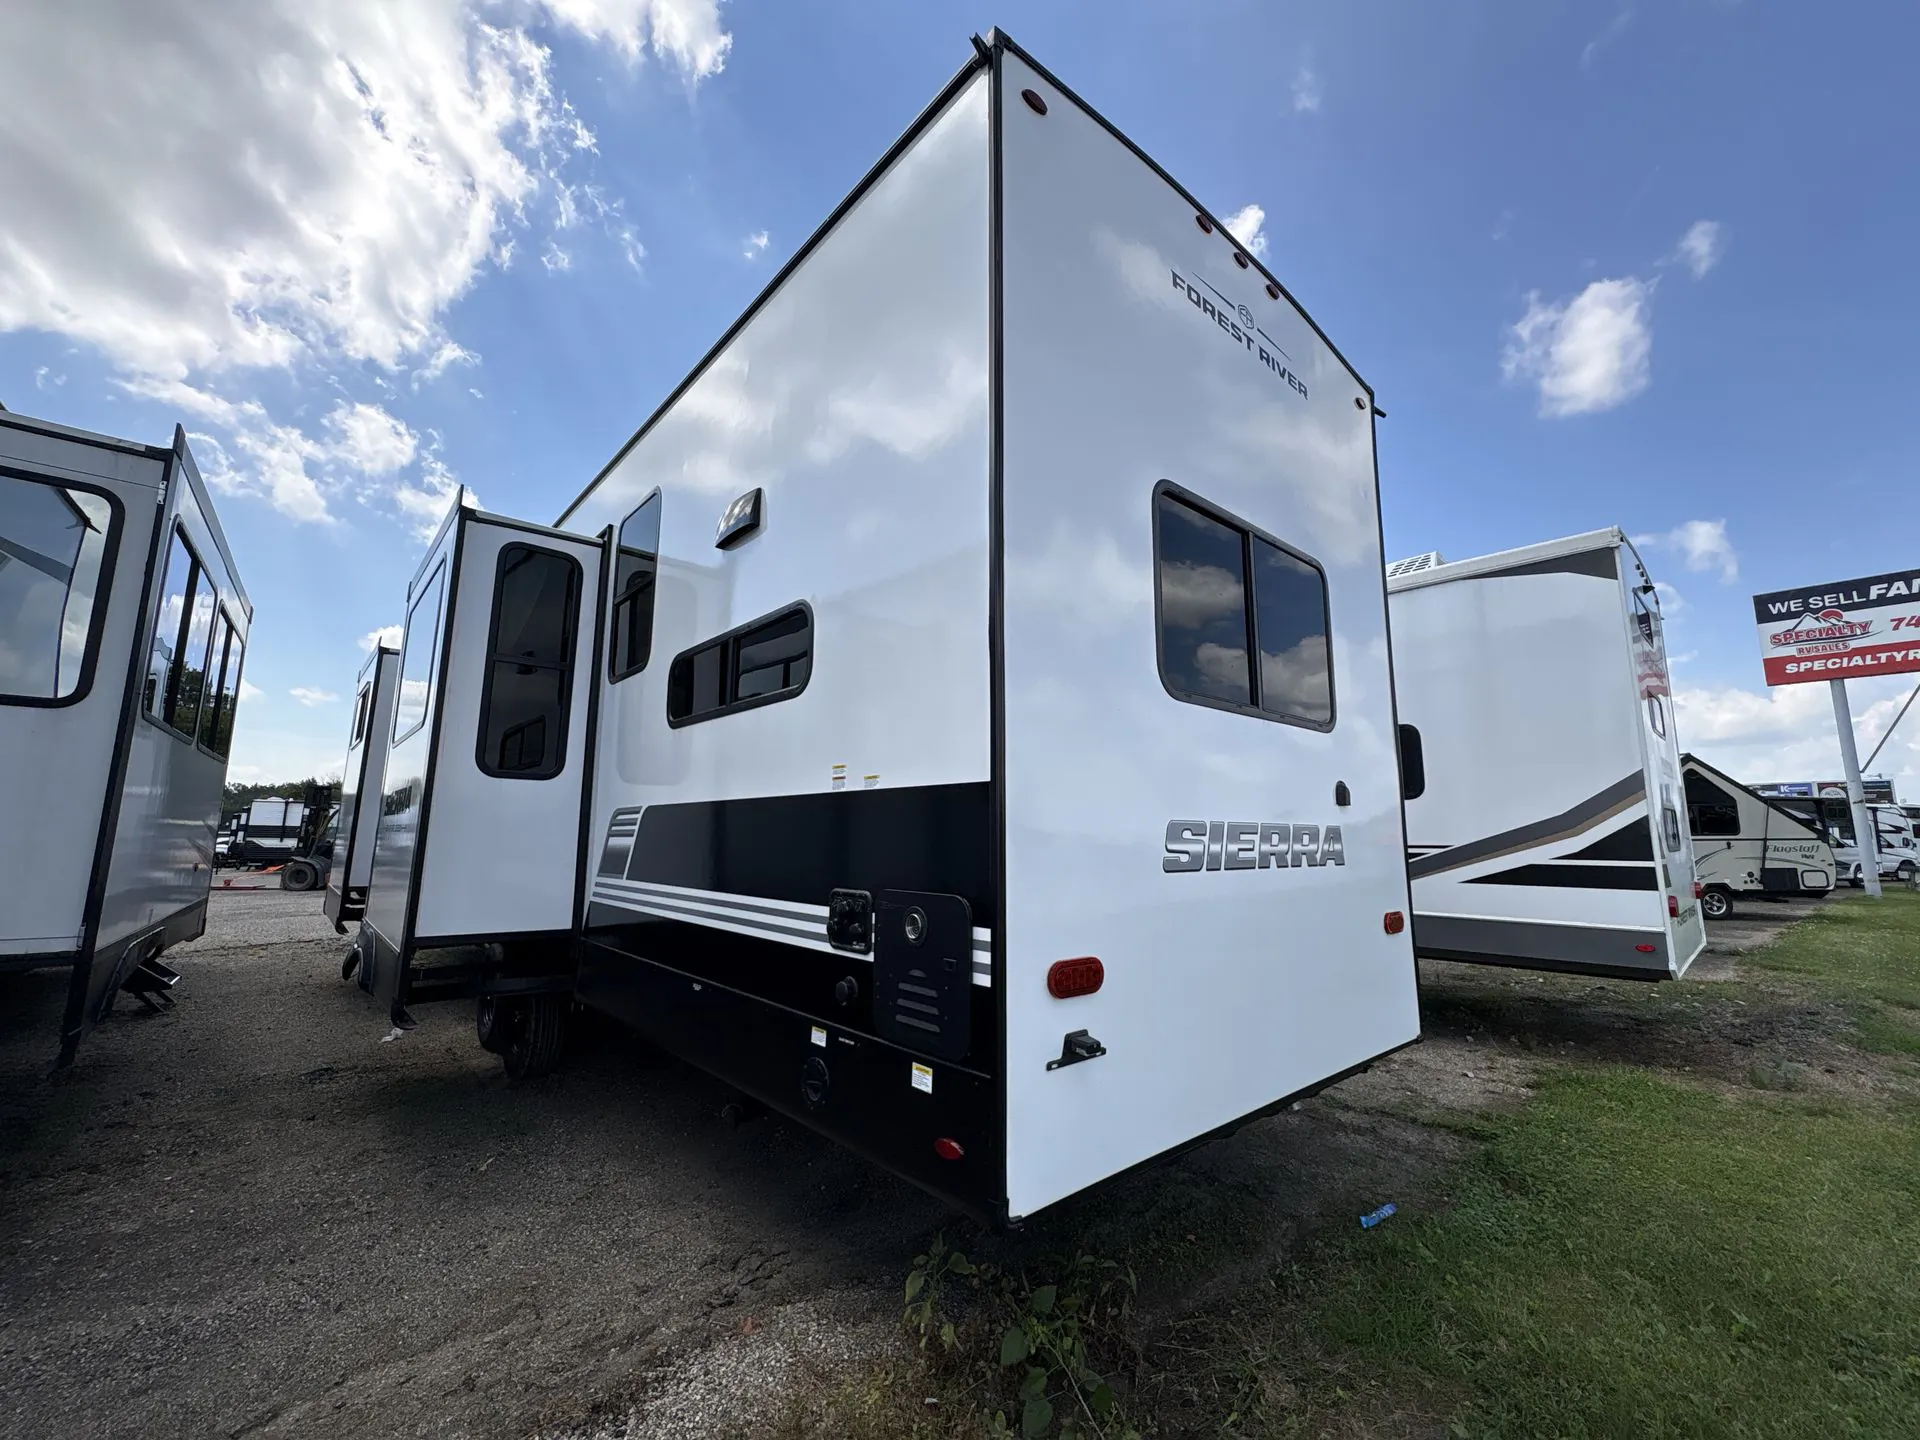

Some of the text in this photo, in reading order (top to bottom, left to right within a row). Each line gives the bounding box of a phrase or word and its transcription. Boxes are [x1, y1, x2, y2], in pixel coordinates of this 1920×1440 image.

[1170, 268, 1308, 401] FOREST RIVER
[1767, 598, 1804, 615] WE
[1808, 590, 1867, 609] SELL
[1770, 620, 1873, 646] SPECIALTY
[1798, 641, 1849, 656] RV SALES
[1162, 819, 1346, 874] SIERRA
[1766, 844, 1821, 854] Flagstaff
